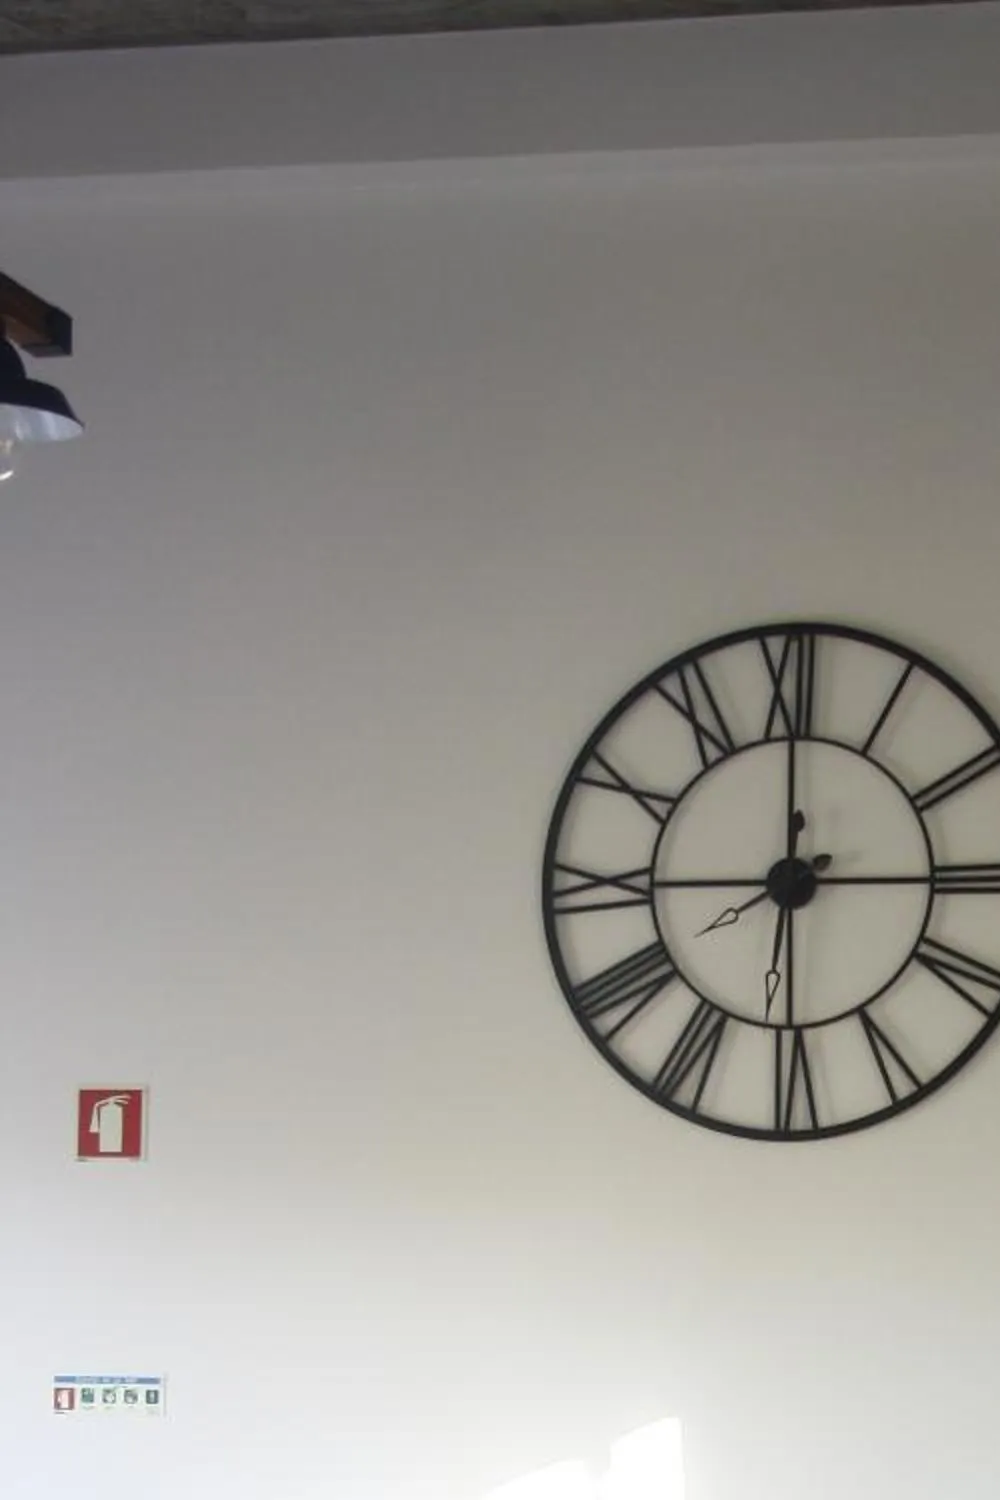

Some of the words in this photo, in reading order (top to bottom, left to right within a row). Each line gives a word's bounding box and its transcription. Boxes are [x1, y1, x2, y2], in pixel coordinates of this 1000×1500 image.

[650, 656, 736, 770] XI
[757, 633, 815, 740] XII
[861, 660, 917, 756] I
[574, 747, 681, 824] X
[550, 863, 655, 915] IX
[772, 1027, 821, 1132] VI
[856, 1006, 926, 1106] V
